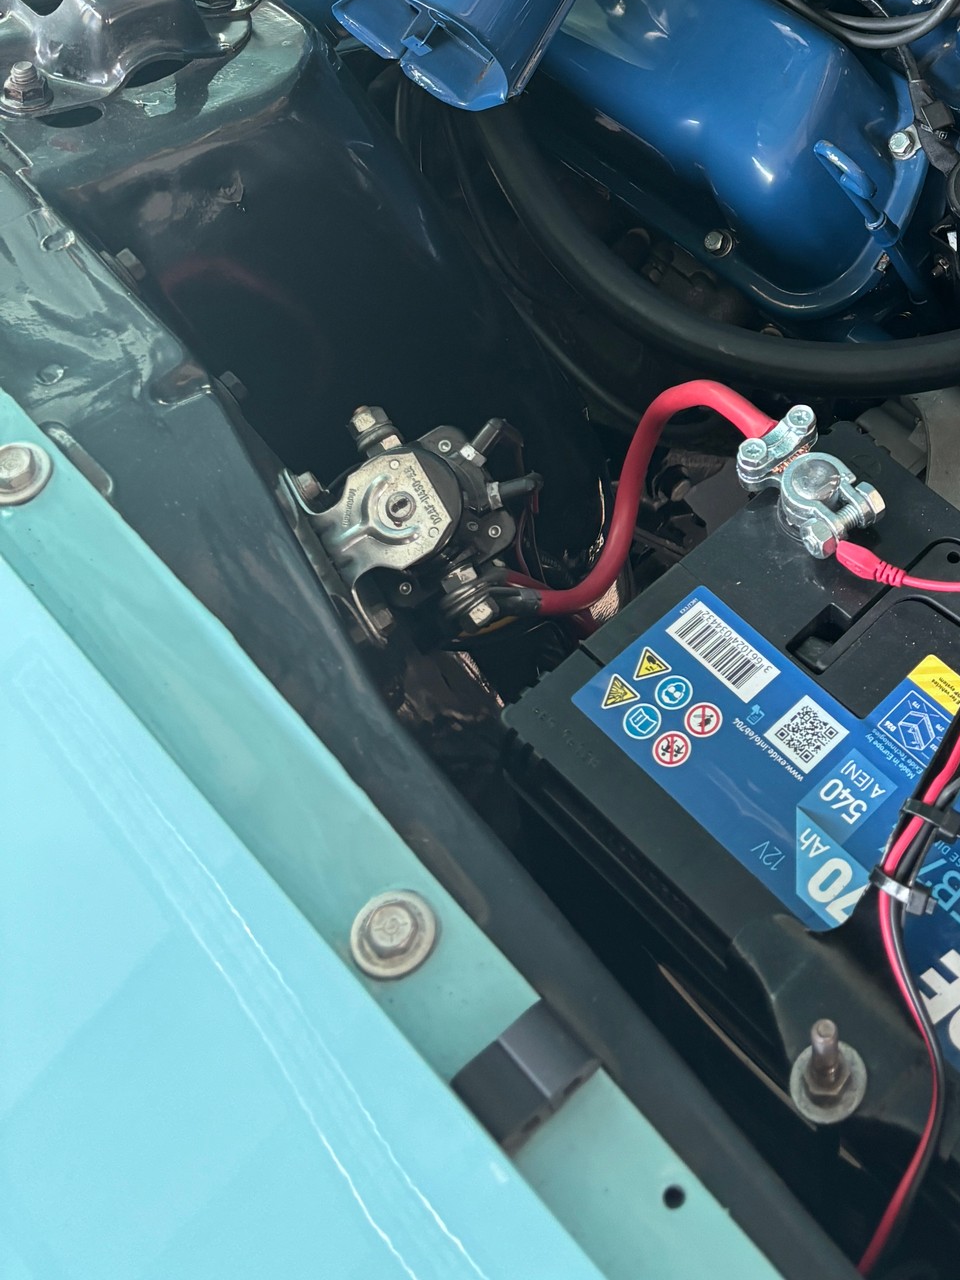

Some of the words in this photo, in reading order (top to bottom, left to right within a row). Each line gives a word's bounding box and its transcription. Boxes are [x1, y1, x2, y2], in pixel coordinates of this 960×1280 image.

[701, 610, 733, 639] 034432
[731, 636, 764, 665] 661024
[931, 678, 950, 695] vehicles
[938, 676, 956, 692] system
[865, 732, 875, 743] by
[884, 720, 897, 732] D26
[732, 717, 805, 781] www.exide.info/eb704
[871, 728, 908, 760] Technologies
[872, 738, 895, 760] Europe
[892, 756, 900, 765] in
[898, 762, 916, 779] Made
[905, 758, 924, 774] Exide
[841, 760, 873, 791] (EN)
[818, 777, 868, 824] 540
[869, 784, 885, 800] A
[799, 827, 834, 859] Ah
[751, 841, 787, 871] 12V
[807, 857, 867, 921] 70
